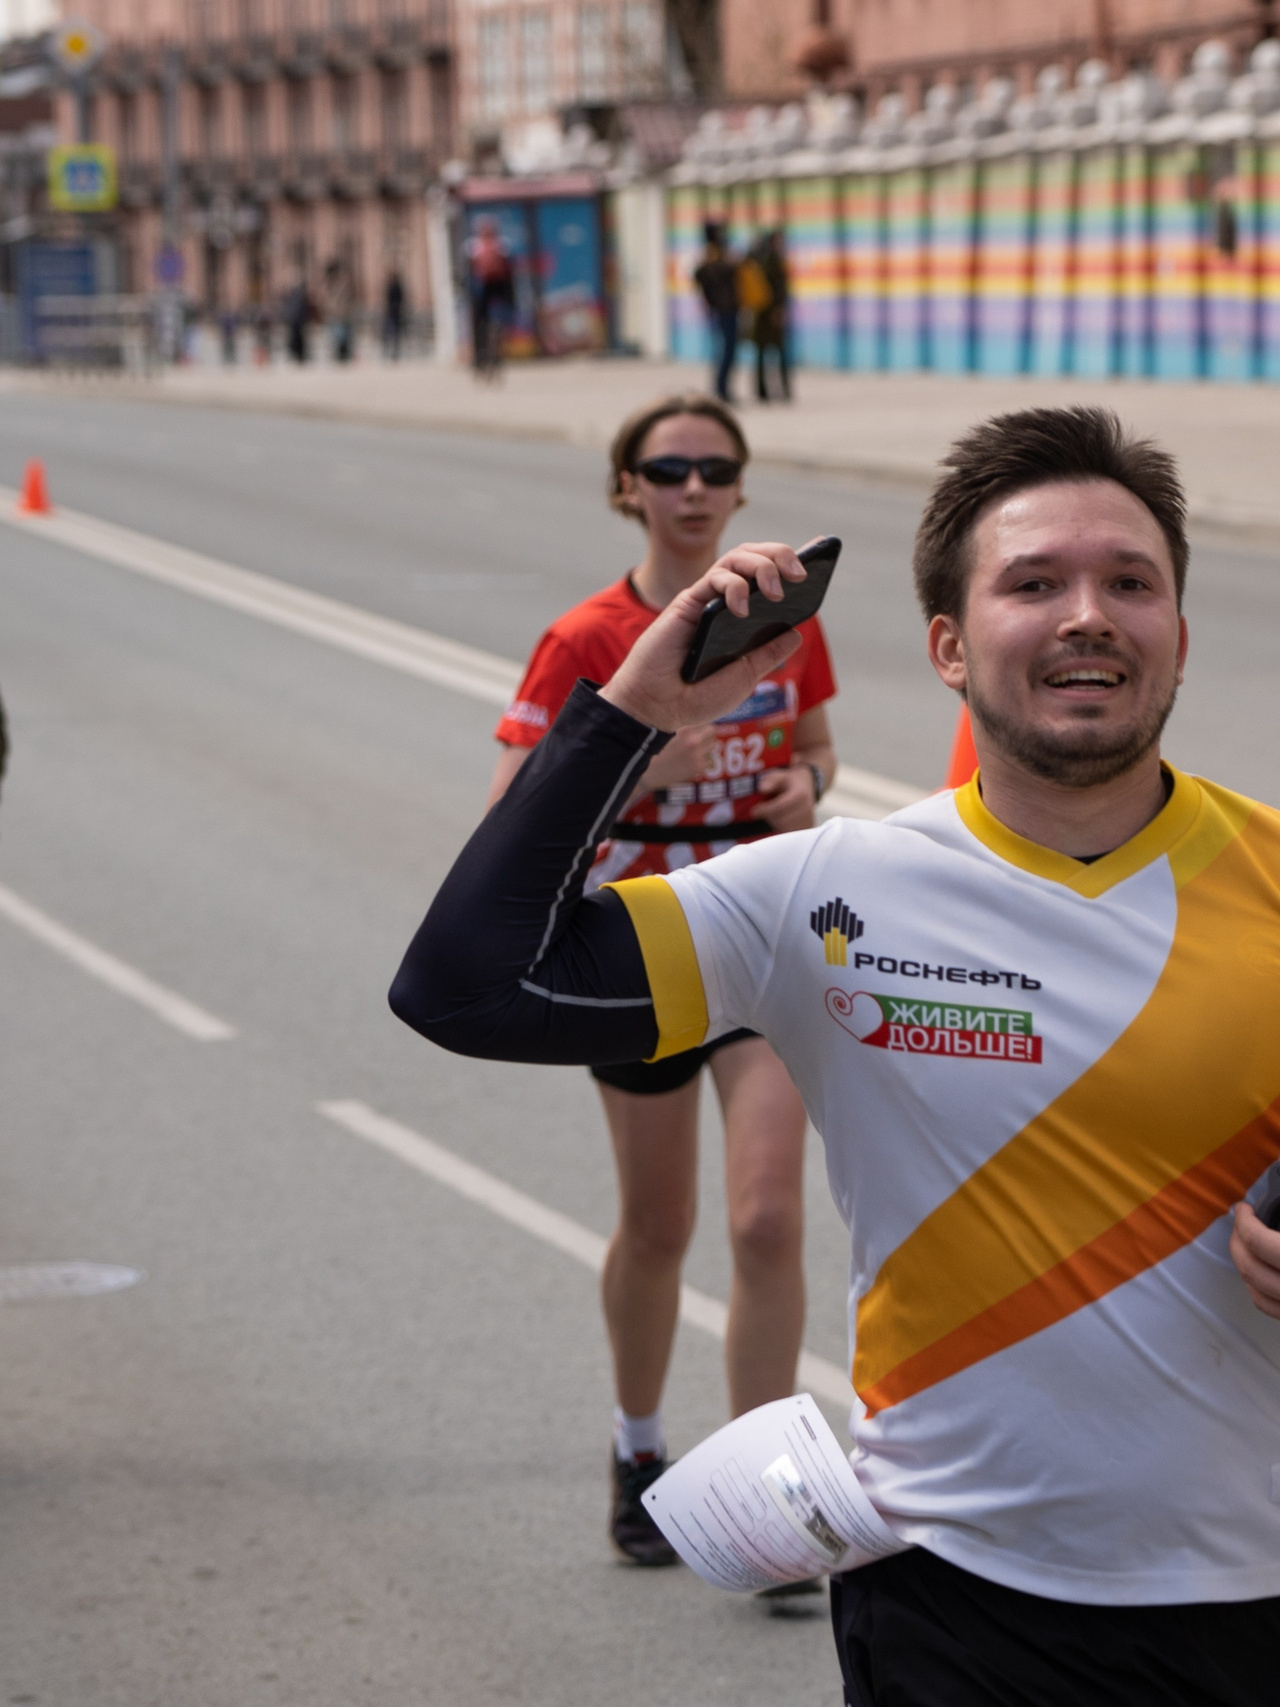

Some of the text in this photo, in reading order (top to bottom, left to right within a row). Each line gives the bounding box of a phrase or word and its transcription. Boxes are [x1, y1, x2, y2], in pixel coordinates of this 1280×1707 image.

[854, 952, 1042, 990] РОСНЕФТЬ
[888, 1001, 1025, 1035] ЖИВИТЕ
[887, 1024, 1033, 1060] ДОЛЬШЕ!
